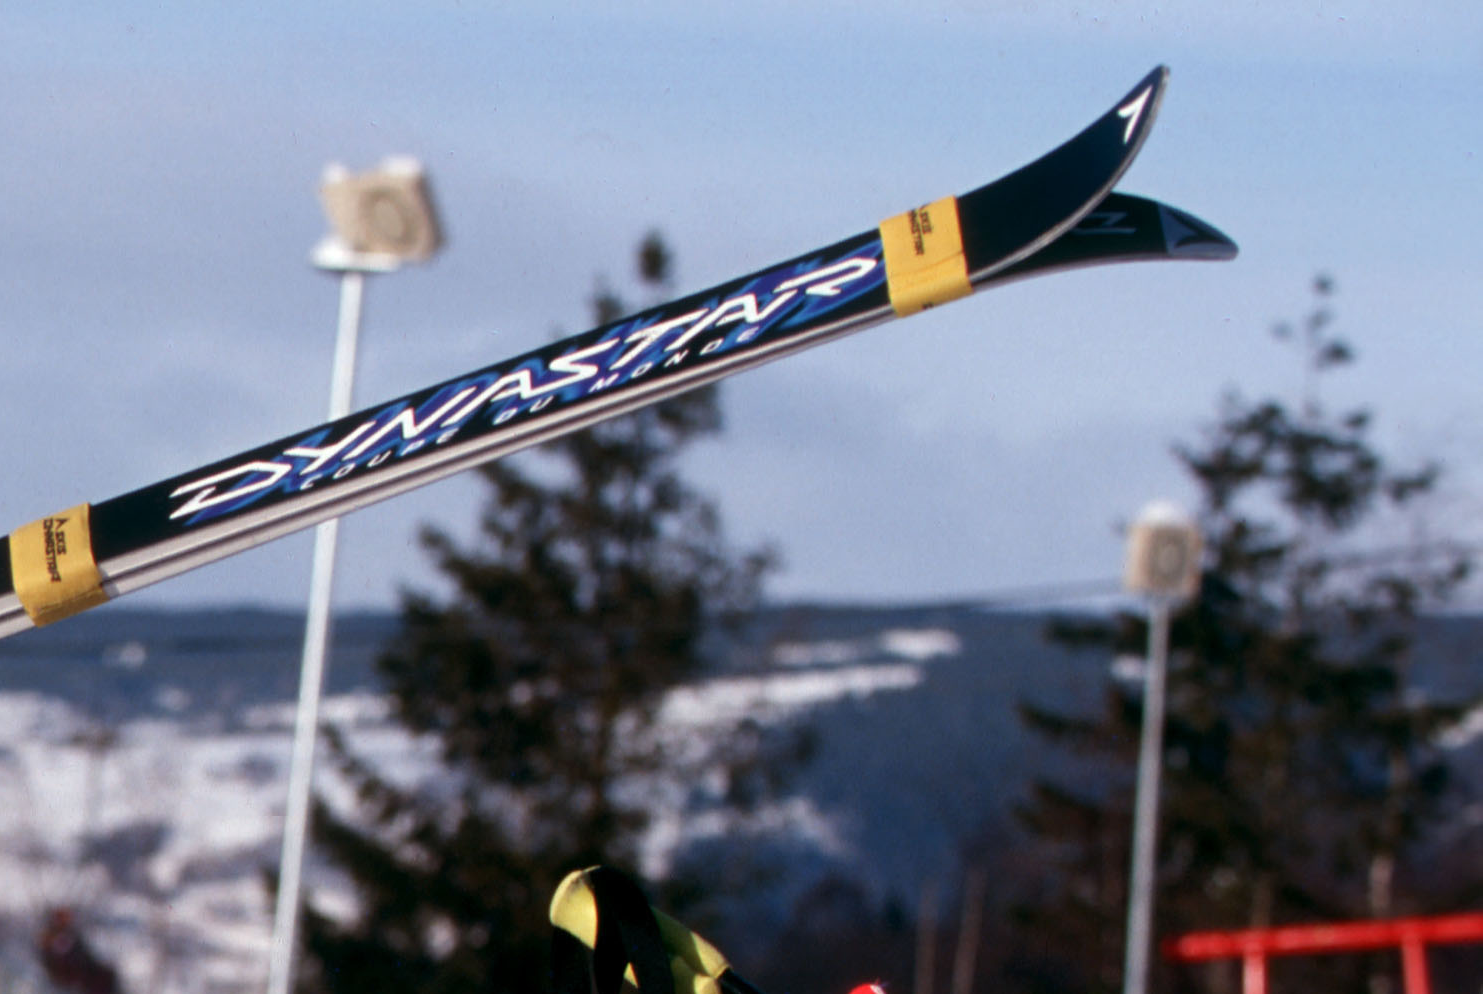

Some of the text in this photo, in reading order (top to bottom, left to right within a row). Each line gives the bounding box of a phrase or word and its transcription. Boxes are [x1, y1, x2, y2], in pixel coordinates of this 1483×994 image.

[169, 256, 877, 520] DYNASTAR
[300, 325, 759, 491] COUPE DU MONDE
